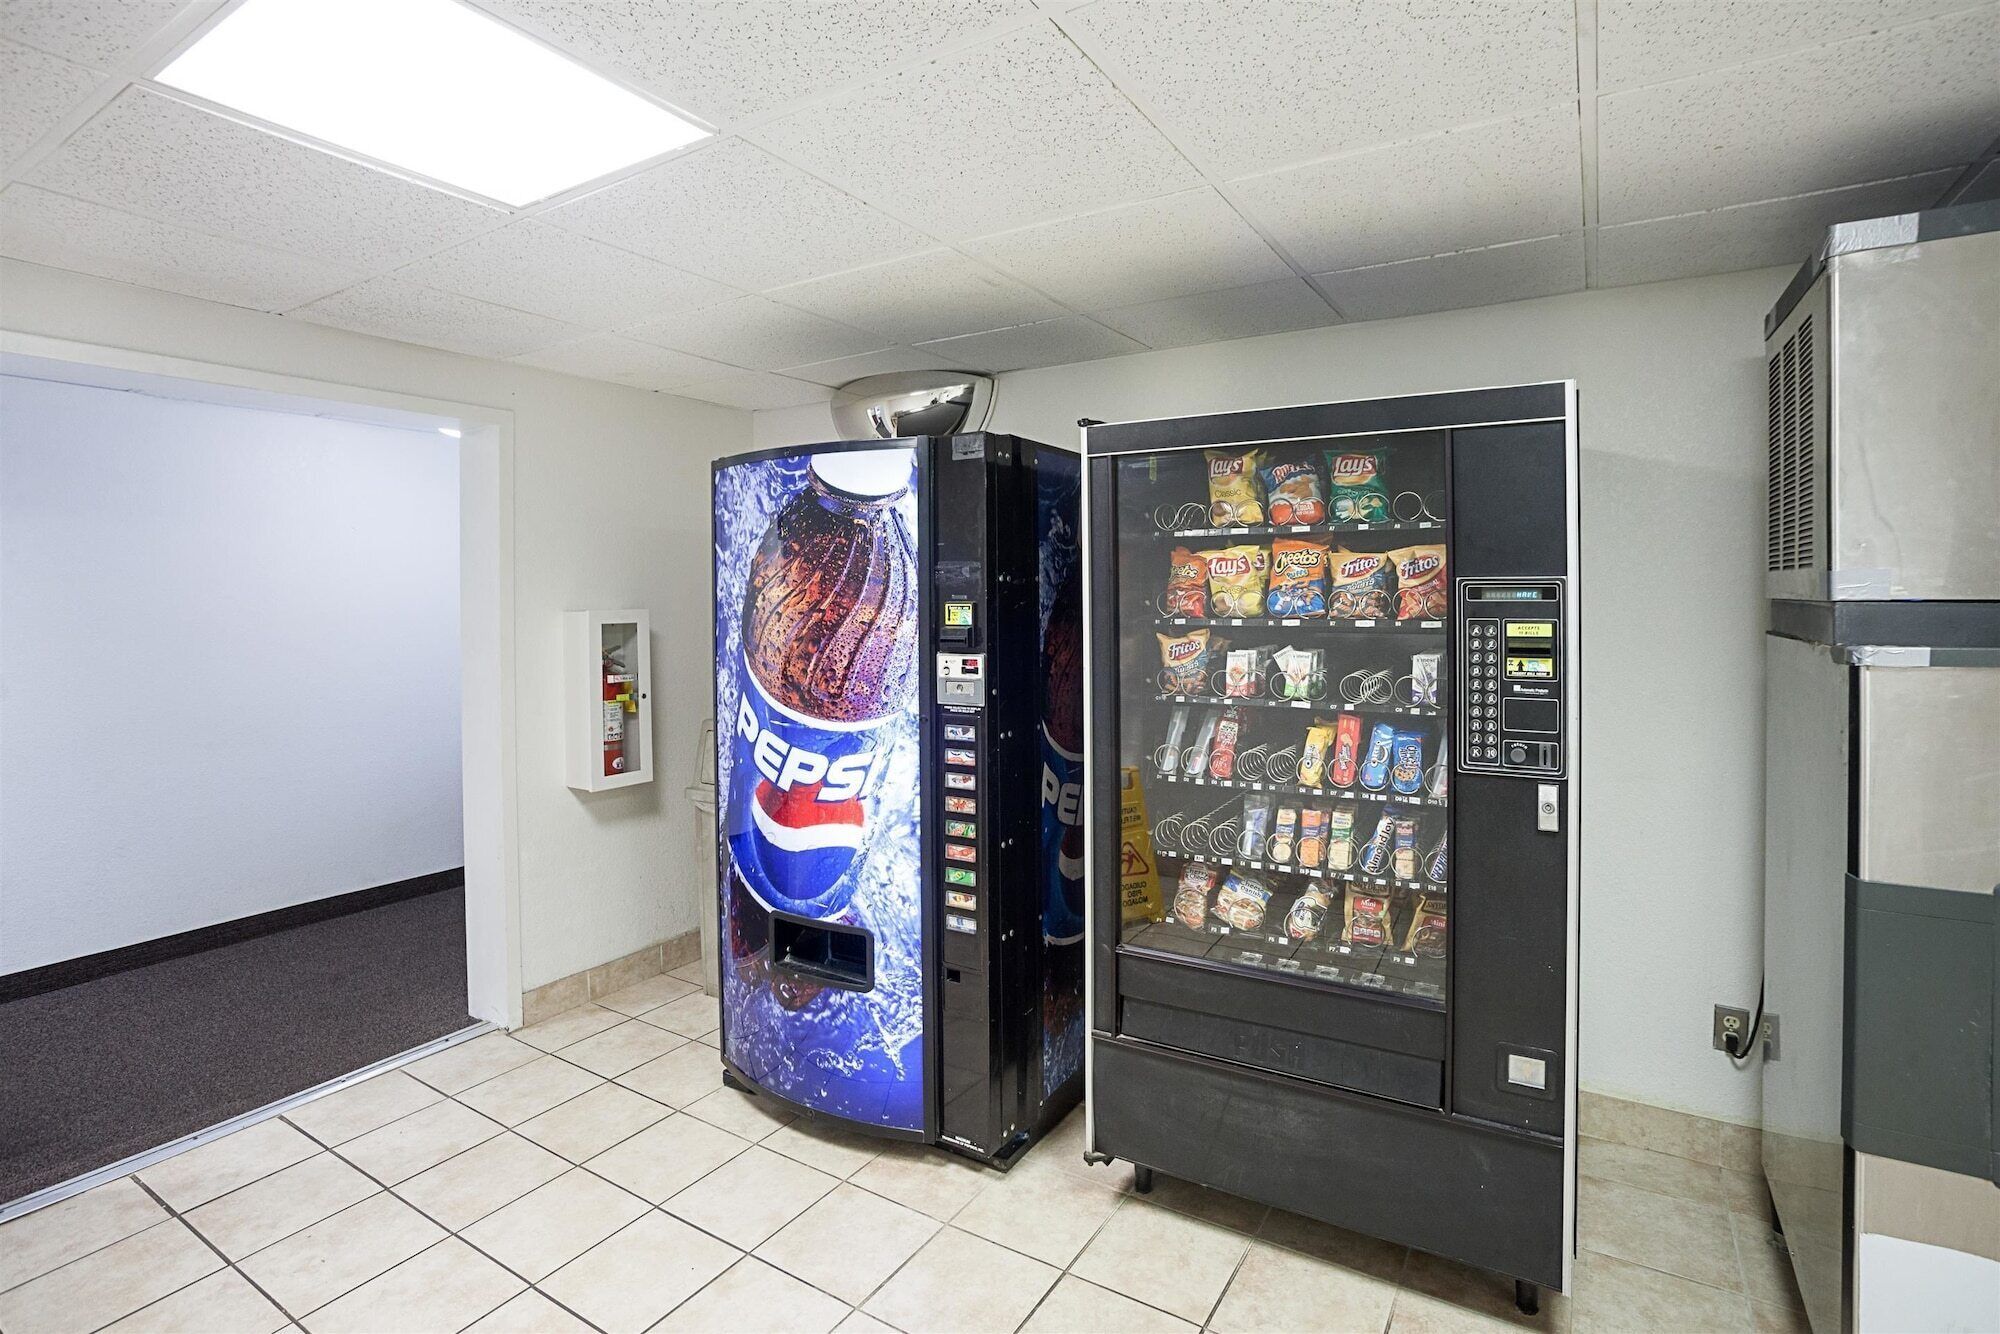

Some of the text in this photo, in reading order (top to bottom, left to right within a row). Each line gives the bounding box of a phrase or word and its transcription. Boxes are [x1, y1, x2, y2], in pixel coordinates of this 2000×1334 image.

[1275, 550, 1320, 574] Cheetos
[1340, 556, 1380, 577] Fritos
[1400, 556, 1440, 578] Fritos
[1168, 640, 1200, 660] Fritos
[736, 692, 879, 800] PEPSI
[1367, 816, 1396, 872] Almond Joy
[1240, 880, 1264, 892] Cheese
[1240, 886, 1262, 898] Danish
[1360, 899, 1376, 908] Mini
